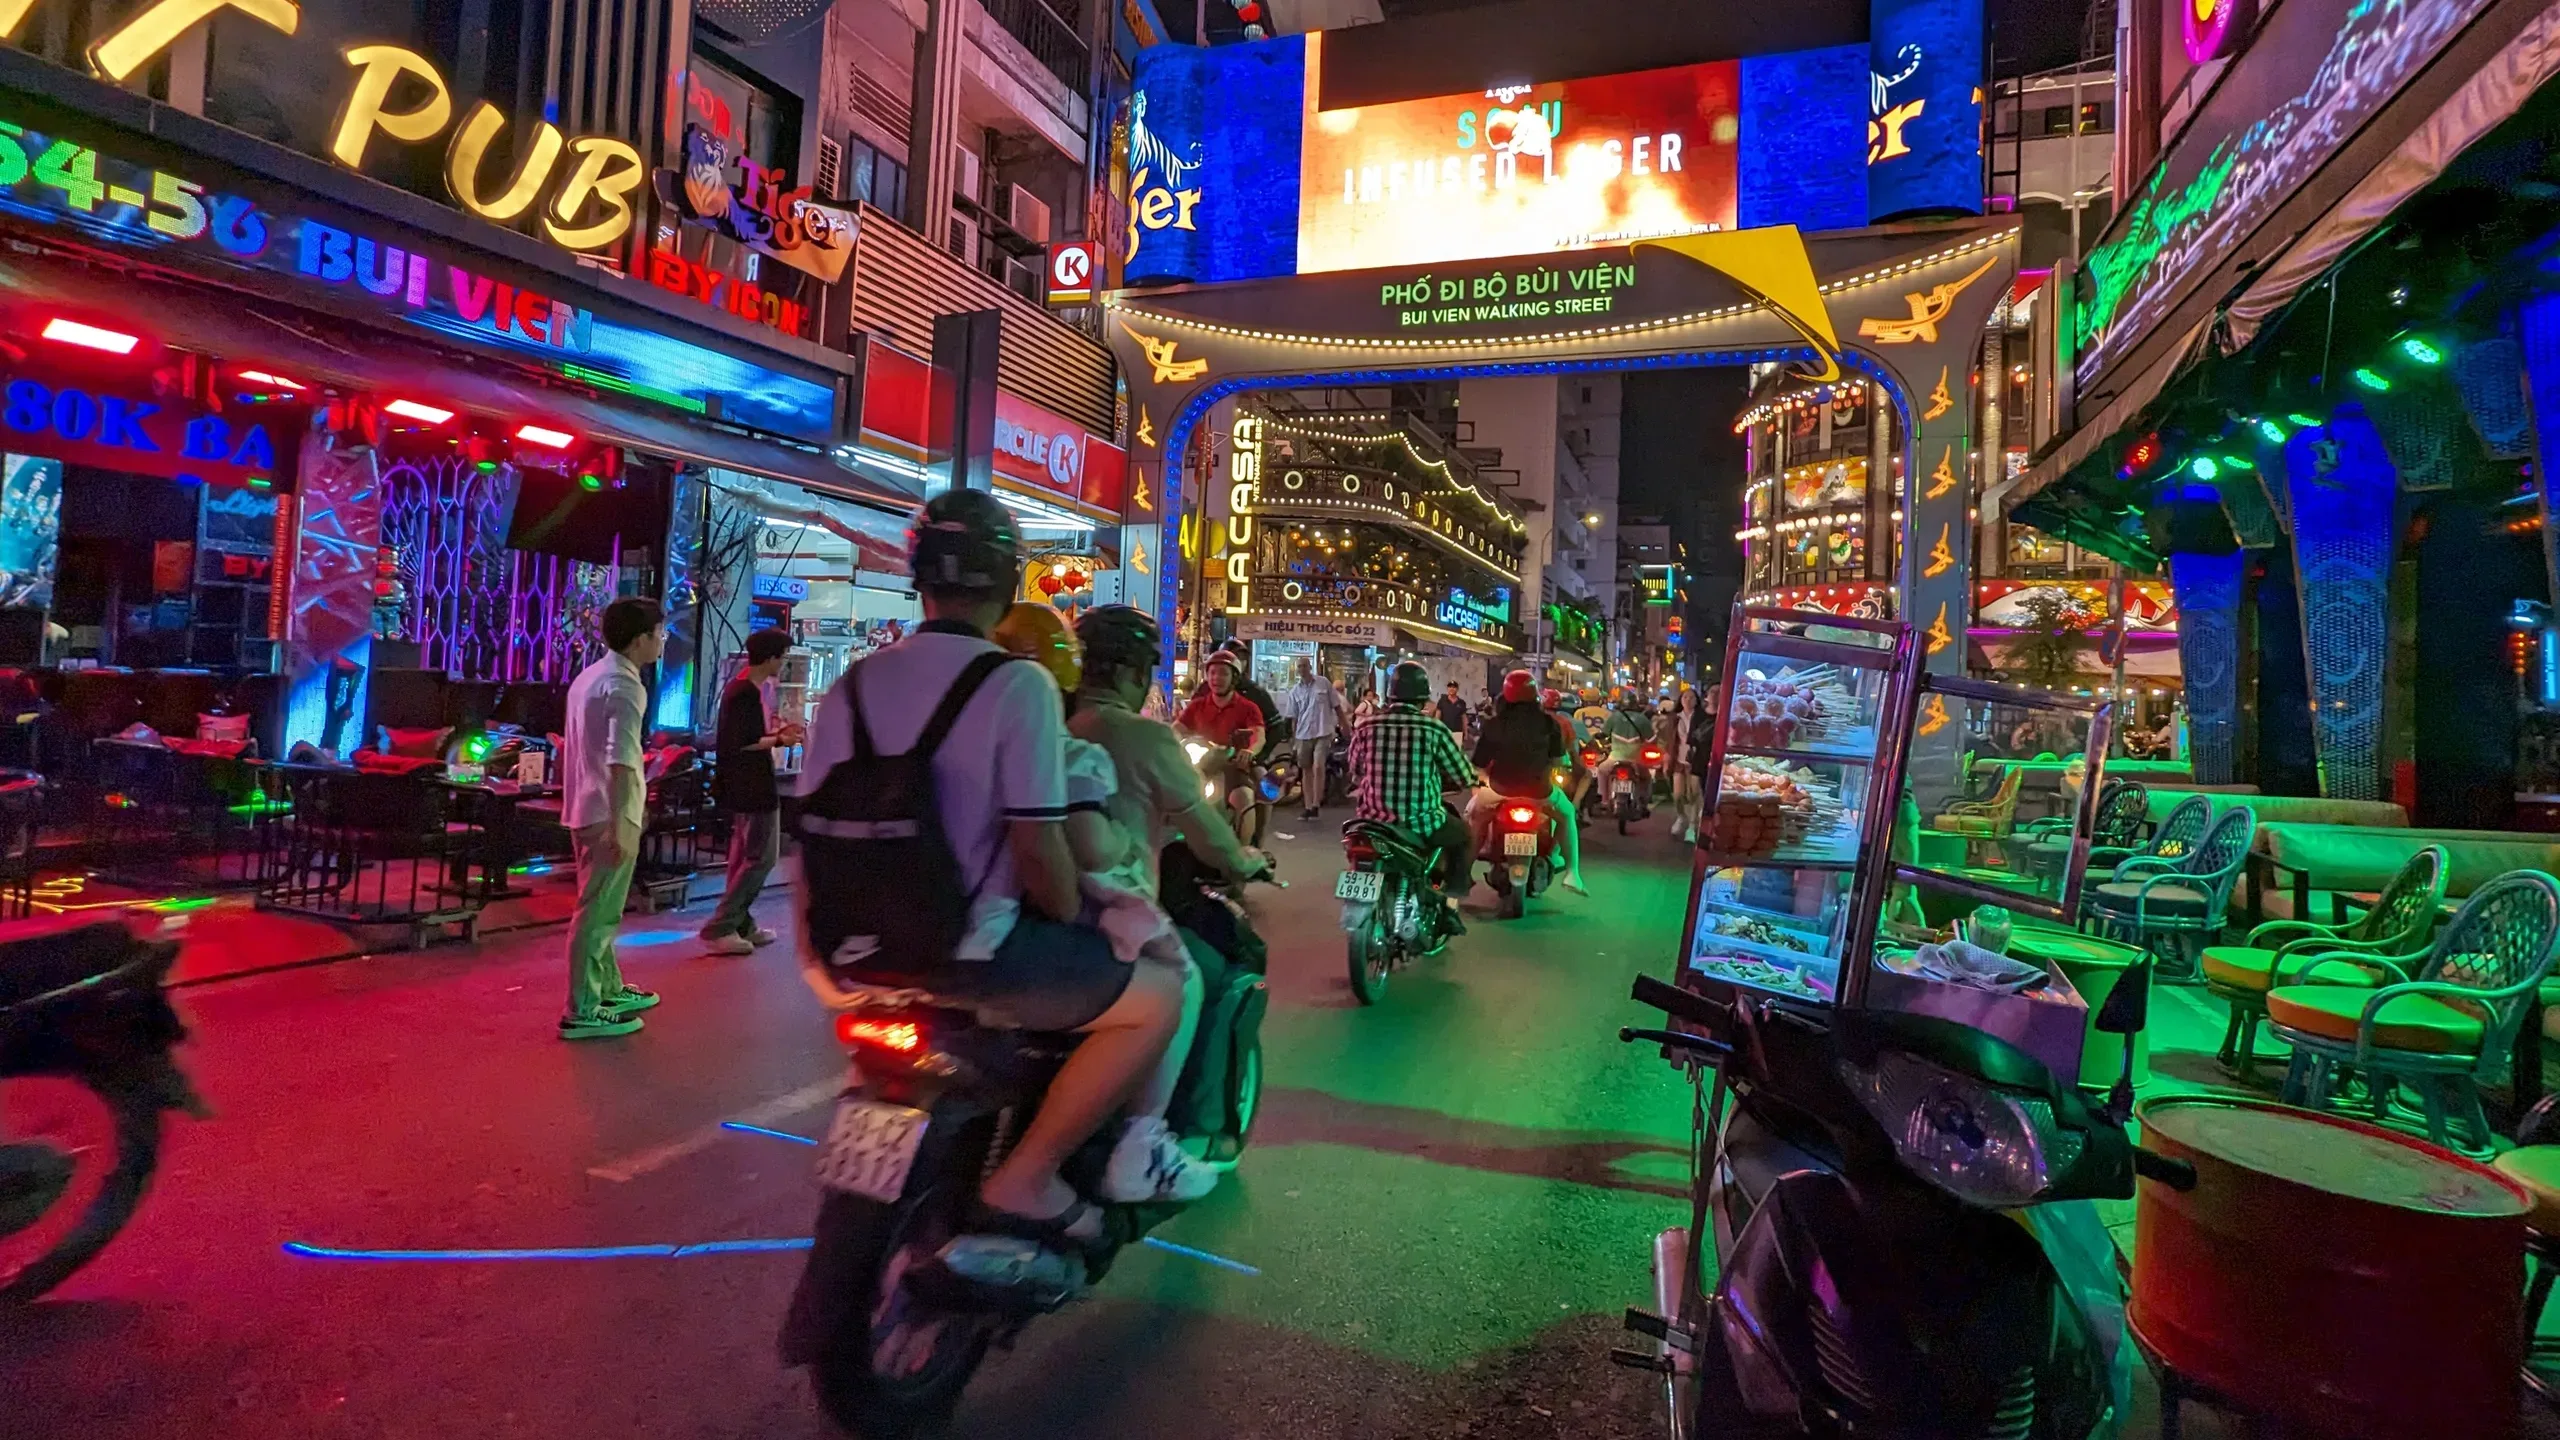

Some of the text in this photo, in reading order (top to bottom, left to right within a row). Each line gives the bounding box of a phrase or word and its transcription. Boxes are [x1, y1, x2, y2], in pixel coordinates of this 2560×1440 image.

[333, 44, 644, 249] PUB
[732, 155, 847, 250] Tiger
[1344, 152, 1516, 205] INFUSED
[301, 218, 428, 305] BUI
[448, 264, 592, 353] VIEN
[651, 249, 800, 337] BY ICON
[1381, 262, 1635, 305] PHỐ ĐI BỘ BÙI VIỆN
[1402, 297, 1612, 325] BUI VIEN WALKING STREET
[3, 379, 161, 452] 80K
[1252, 441, 1262, 501] VIETNAMESE
[758, 578, 788, 594] HSBC
[1264, 620, 1375, 636] HIỆU THUỐC SỐ 22
[1582, 711, 1605, 728] be
[1344, 871, 1376, 886] 59-T2
